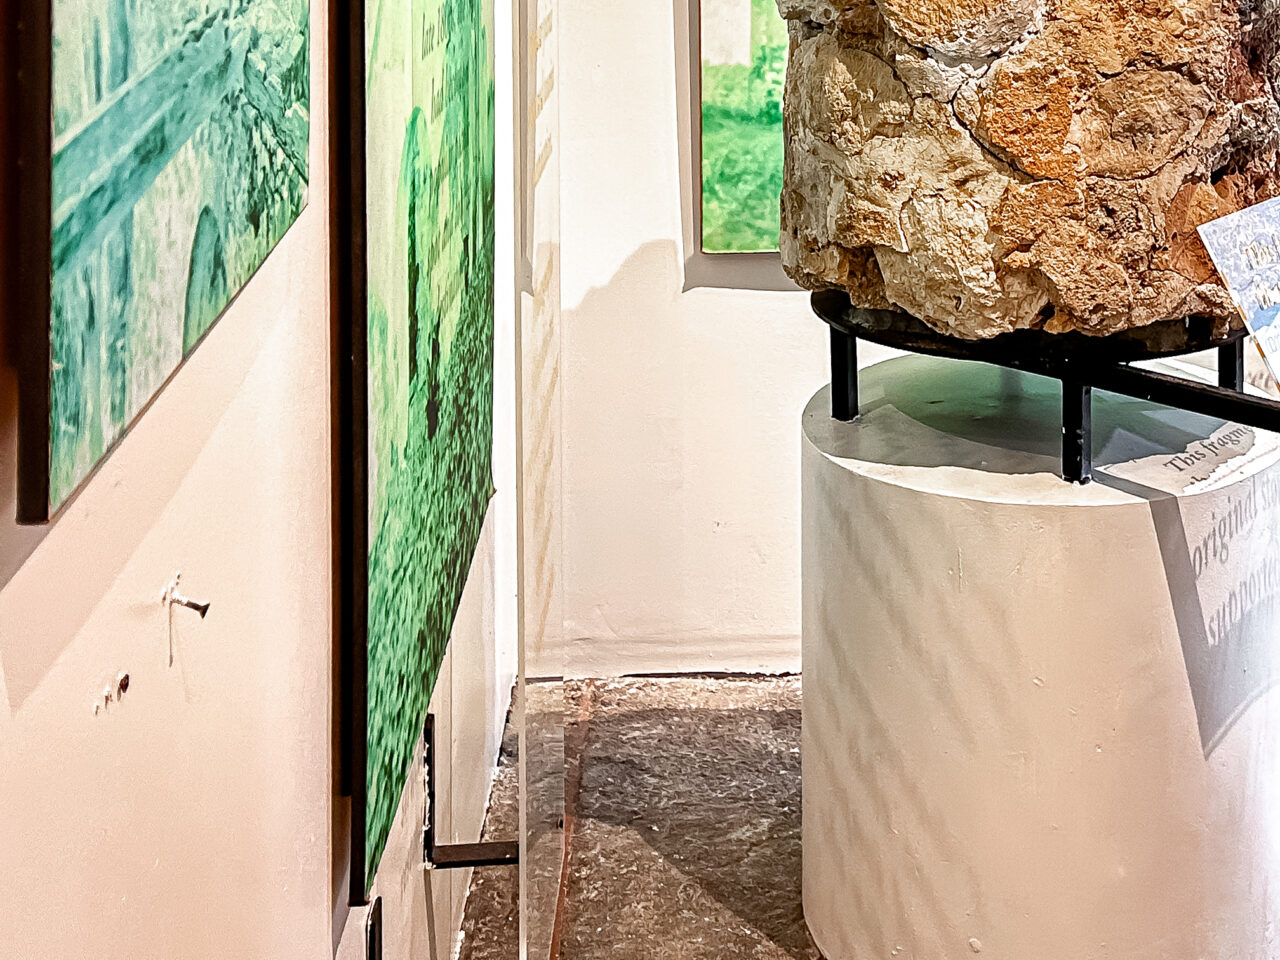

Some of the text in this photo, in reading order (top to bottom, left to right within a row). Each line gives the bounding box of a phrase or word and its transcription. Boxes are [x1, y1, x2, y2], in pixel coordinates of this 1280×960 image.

[1163, 424, 1254, 472] This fragme
[1193, 473, 1258, 578] original
